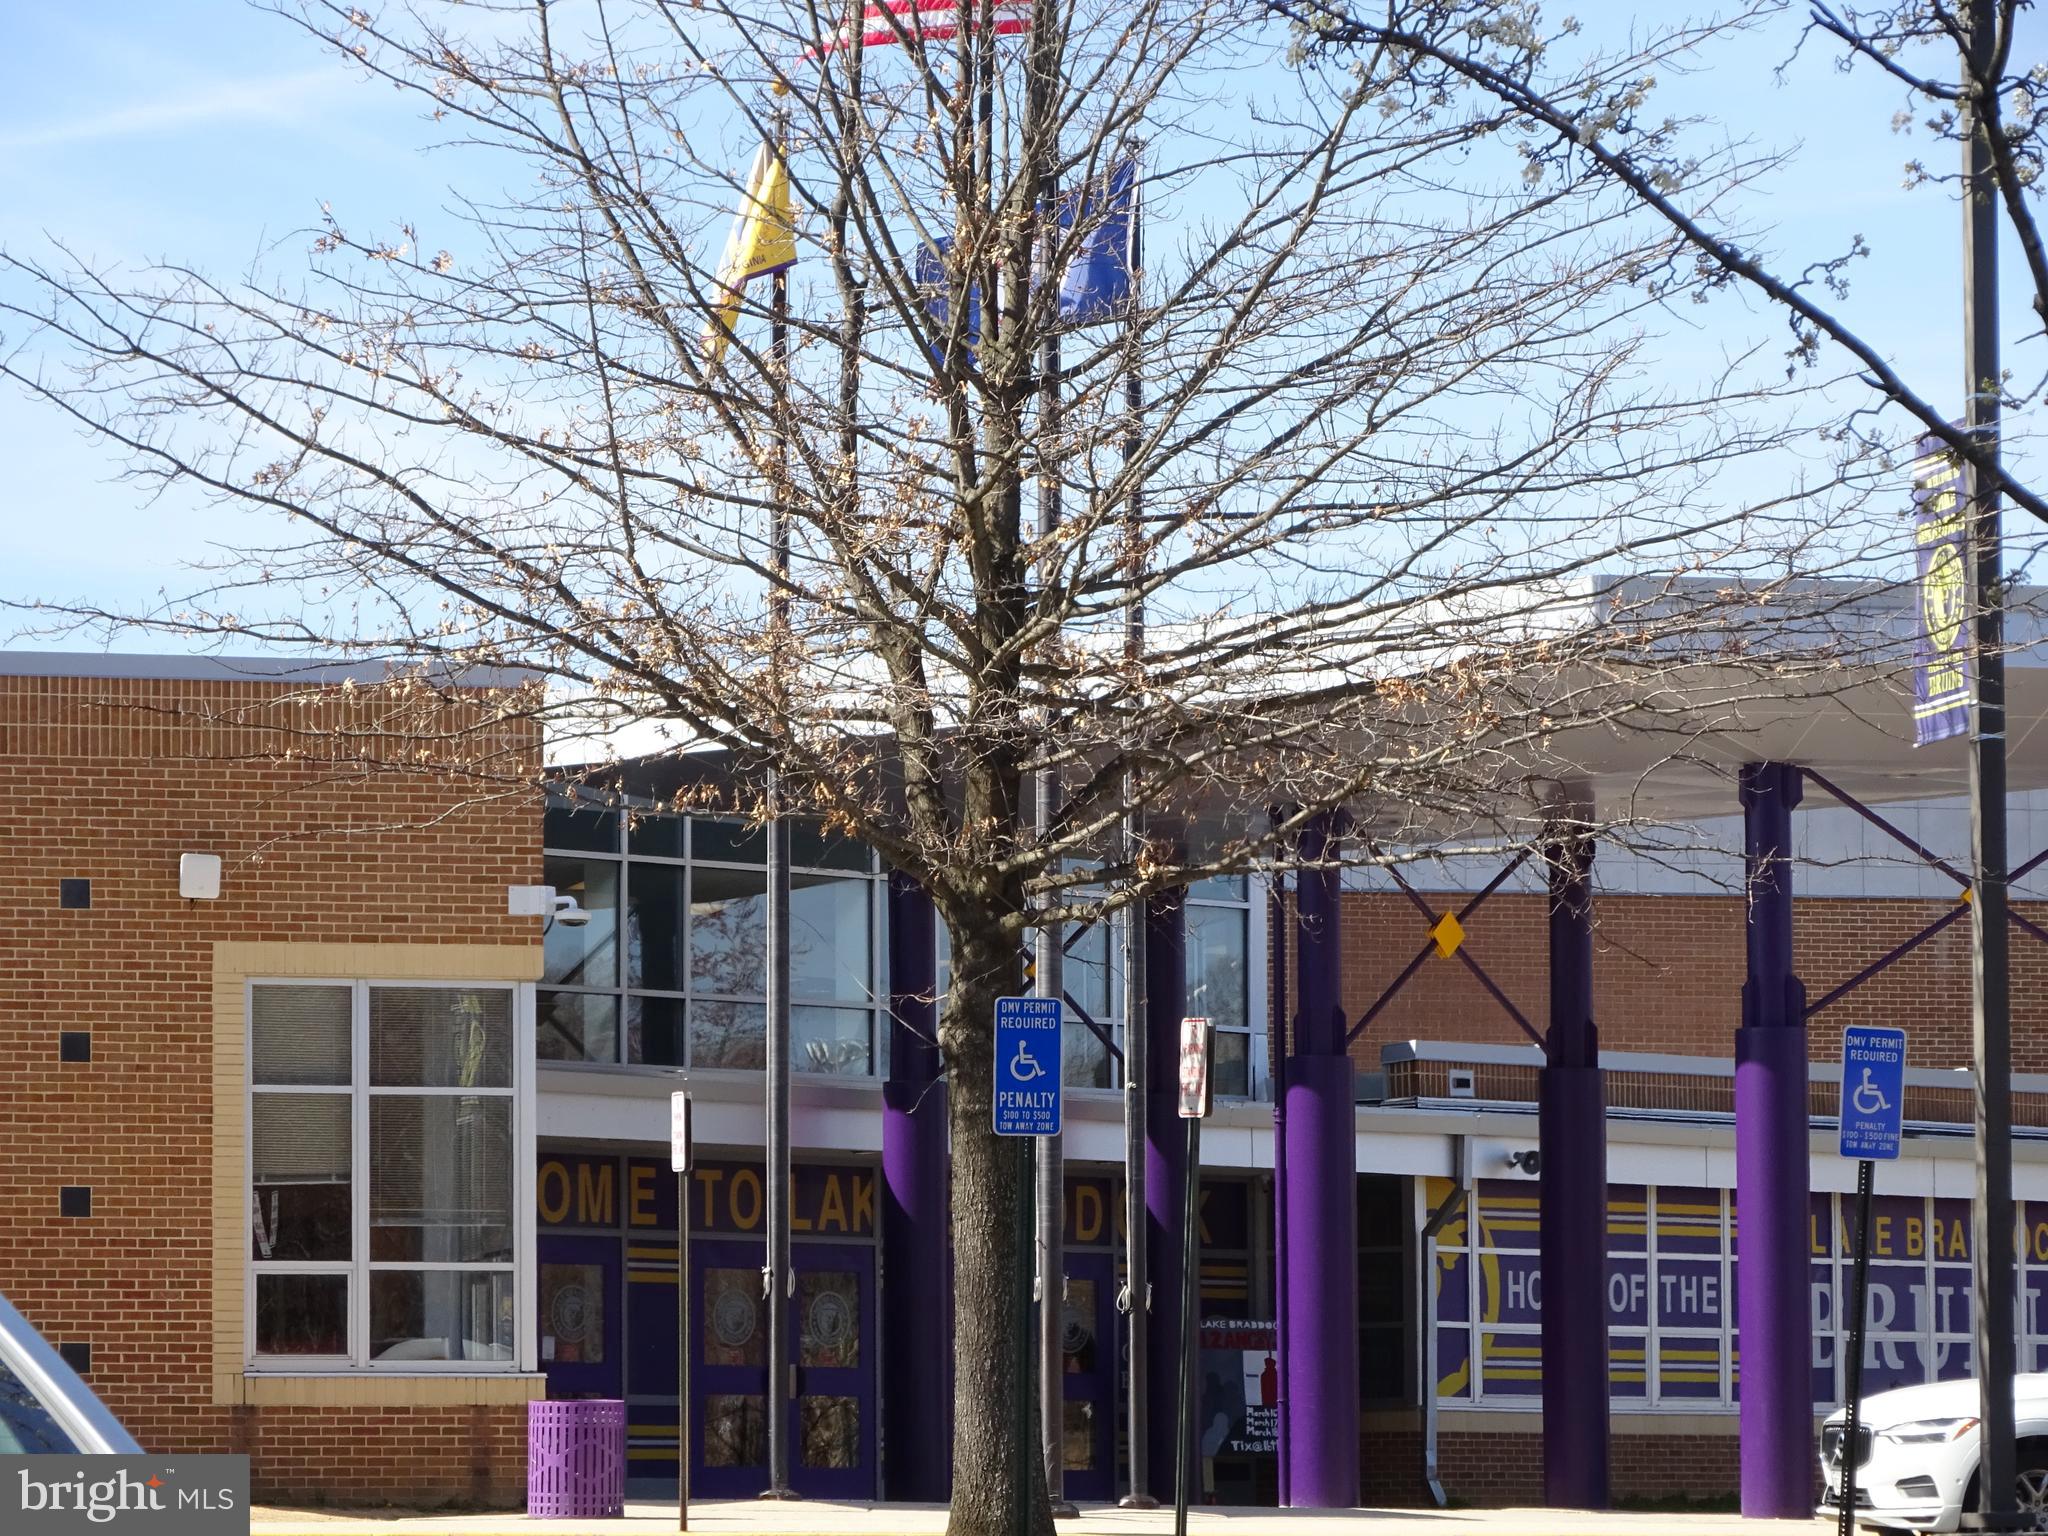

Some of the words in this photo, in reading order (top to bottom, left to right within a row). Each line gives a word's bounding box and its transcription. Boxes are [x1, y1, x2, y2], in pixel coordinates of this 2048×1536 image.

[1001, 1002, 1021, 1014] DMV
[1023, 1002, 1056, 1014] PERMIT
[1001, 1017, 1056, 1029] REQUIRED
[1847, 1035, 1867, 1047] DMV
[1870, 1037, 1903, 1049] PERMIT
[1850, 1049, 1898, 1063] REQUIRED
[1000, 1091, 1056, 1108] PENALTY
[1003, 1110, 1019, 1120] $100
[1022, 1110, 1030, 1120] TO
[1033, 1111, 1051, 1120] $500
[999, 1121, 1012, 1131] TOW
[1015, 1122, 1034, 1131] AWAY
[1036, 1122, 1054, 1131] ZONE
[1855, 1121, 1886, 1131] PENALTY
[695, 1168, 763, 1230] TO
[1608, 1272, 1646, 1313] OF
[1660, 1275, 1718, 1314] THE
[1200, 1320, 1226, 1329] LAKE
[1246, 1406, 1270, 1417] March
[1246, 1417, 1270, 1427] March
[1246, 1426, 1270, 1436] March
